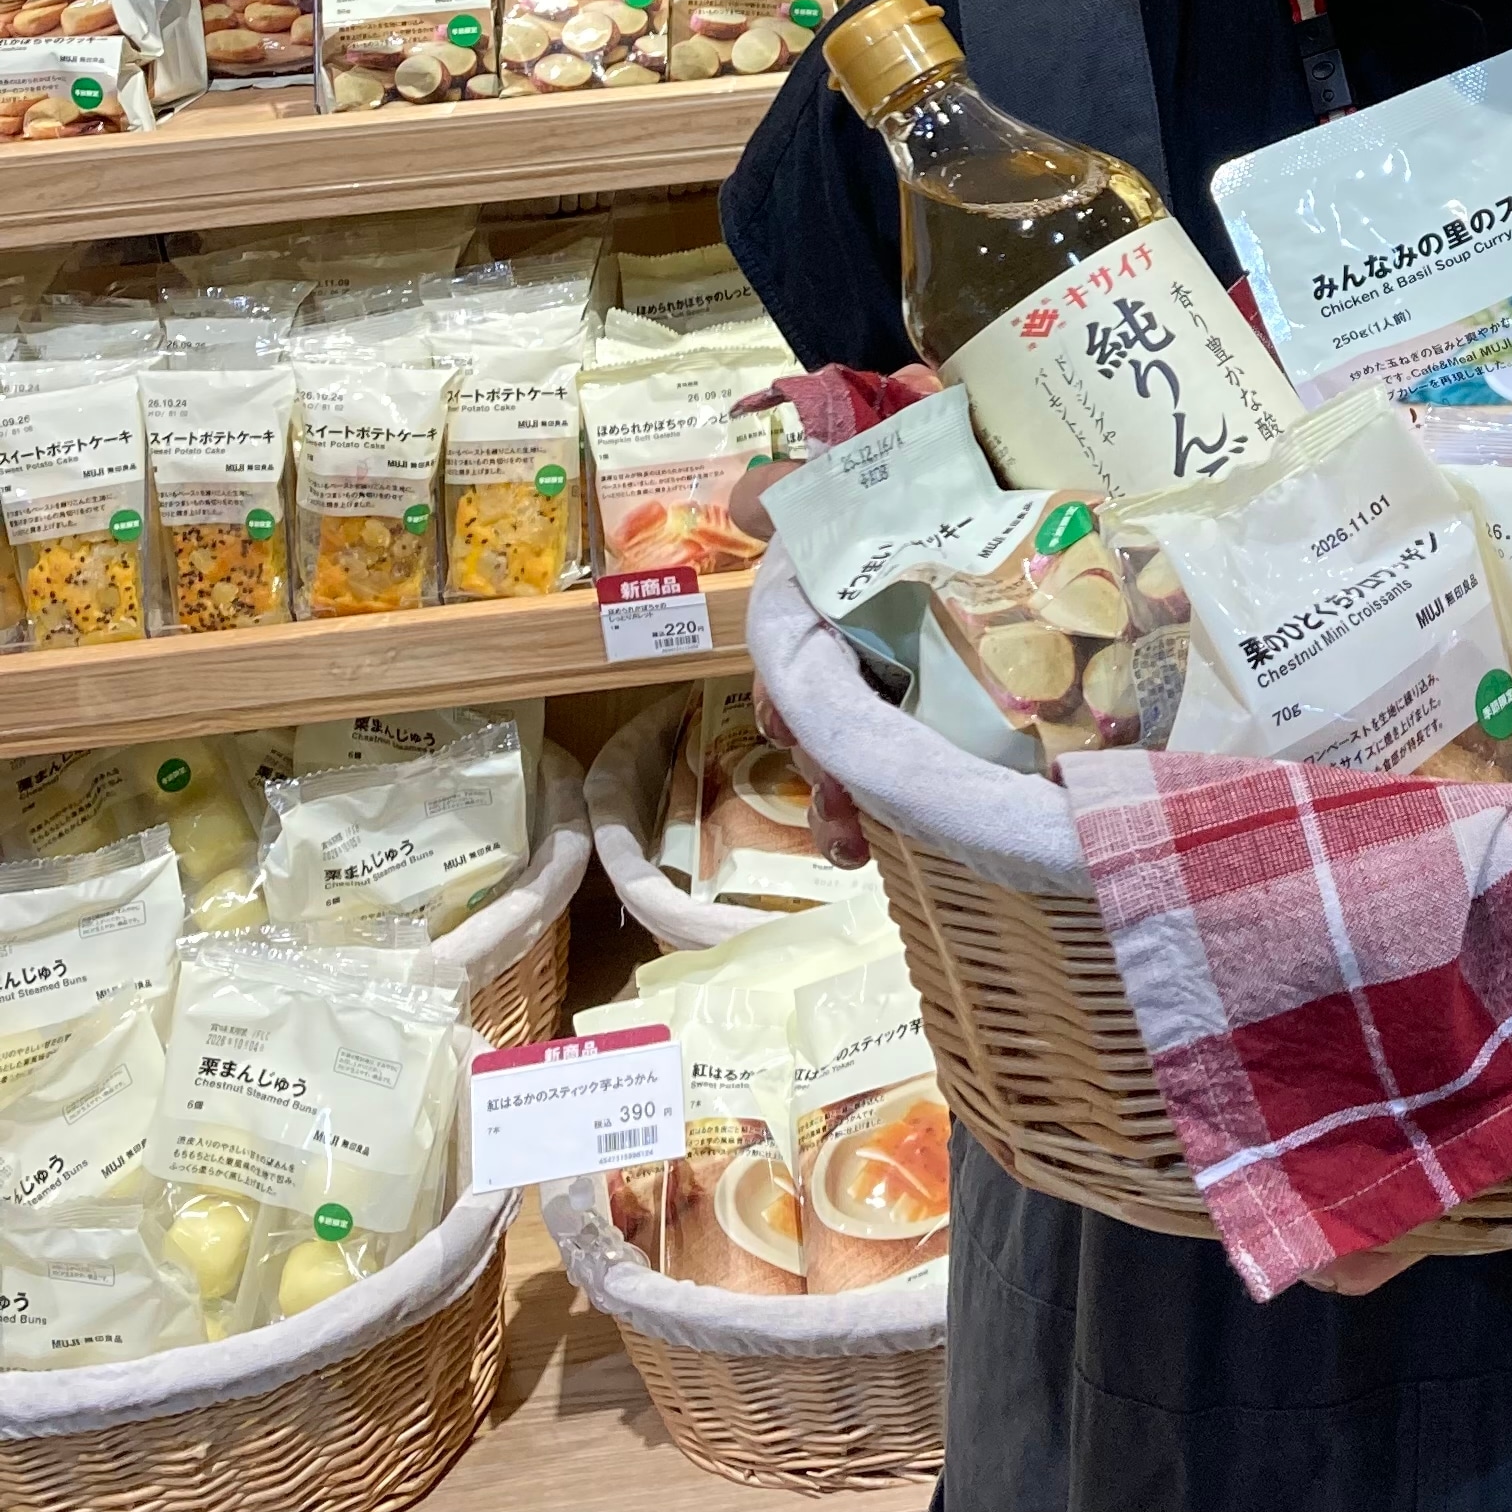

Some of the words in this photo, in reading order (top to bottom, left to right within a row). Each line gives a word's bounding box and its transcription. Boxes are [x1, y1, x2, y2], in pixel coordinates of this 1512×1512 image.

[1062, 242, 1154, 309] キサイチ
[1320, 287, 1380, 319] Chicken
[1382, 281, 1394, 295] &
[1396, 263, 1433, 289] Basil
[1435, 250, 1471, 275] Soup
[1473, 228, 1512, 260] Curry
[1332, 309, 1412, 350] 250g(1人前)
[1480, 339, 1512, 357] MUJI
[150, 430, 275, 446] スイートポテトケーキ
[305, 423, 437, 441] スイートポテトケーキ
[0, 430, 132, 464] スイートポテトケーキ
[1310, 494, 1392, 558] 2026.11.01
[621, 576, 680, 600] 新商品
[1415, 597, 1445, 630] MUJI
[1445, 573, 1479, 608] 無印良品
[1256, 638, 1326, 689] Chestnut
[1324, 620, 1349, 649] Mini
[1348, 577, 1413, 628] Croissants
[1271, 702, 1302, 728] 70g
[324, 839, 415, 881] 栗まんじゅう
[410, 849, 434, 865] Buns
[443, 854, 467, 872] MUJI
[18, 980, 60, 999] Steamed
[63, 974, 88, 986] Buns
[544, 1041, 598, 1062] 新商品
[198, 1056, 307, 1098] 栗まんじゅう
[194, 1077, 244, 1095] Chestnut
[246, 1087, 289, 1108] Steamed
[292, 1100, 318, 1116] Buns
[487, 1070, 658, 1112] 紅はるかのスティック芋ようかん
[187, 1100, 204, 1110] 6個
[620, 1101, 656, 1123] 390
[100, 1158, 126, 1179] MUJI
